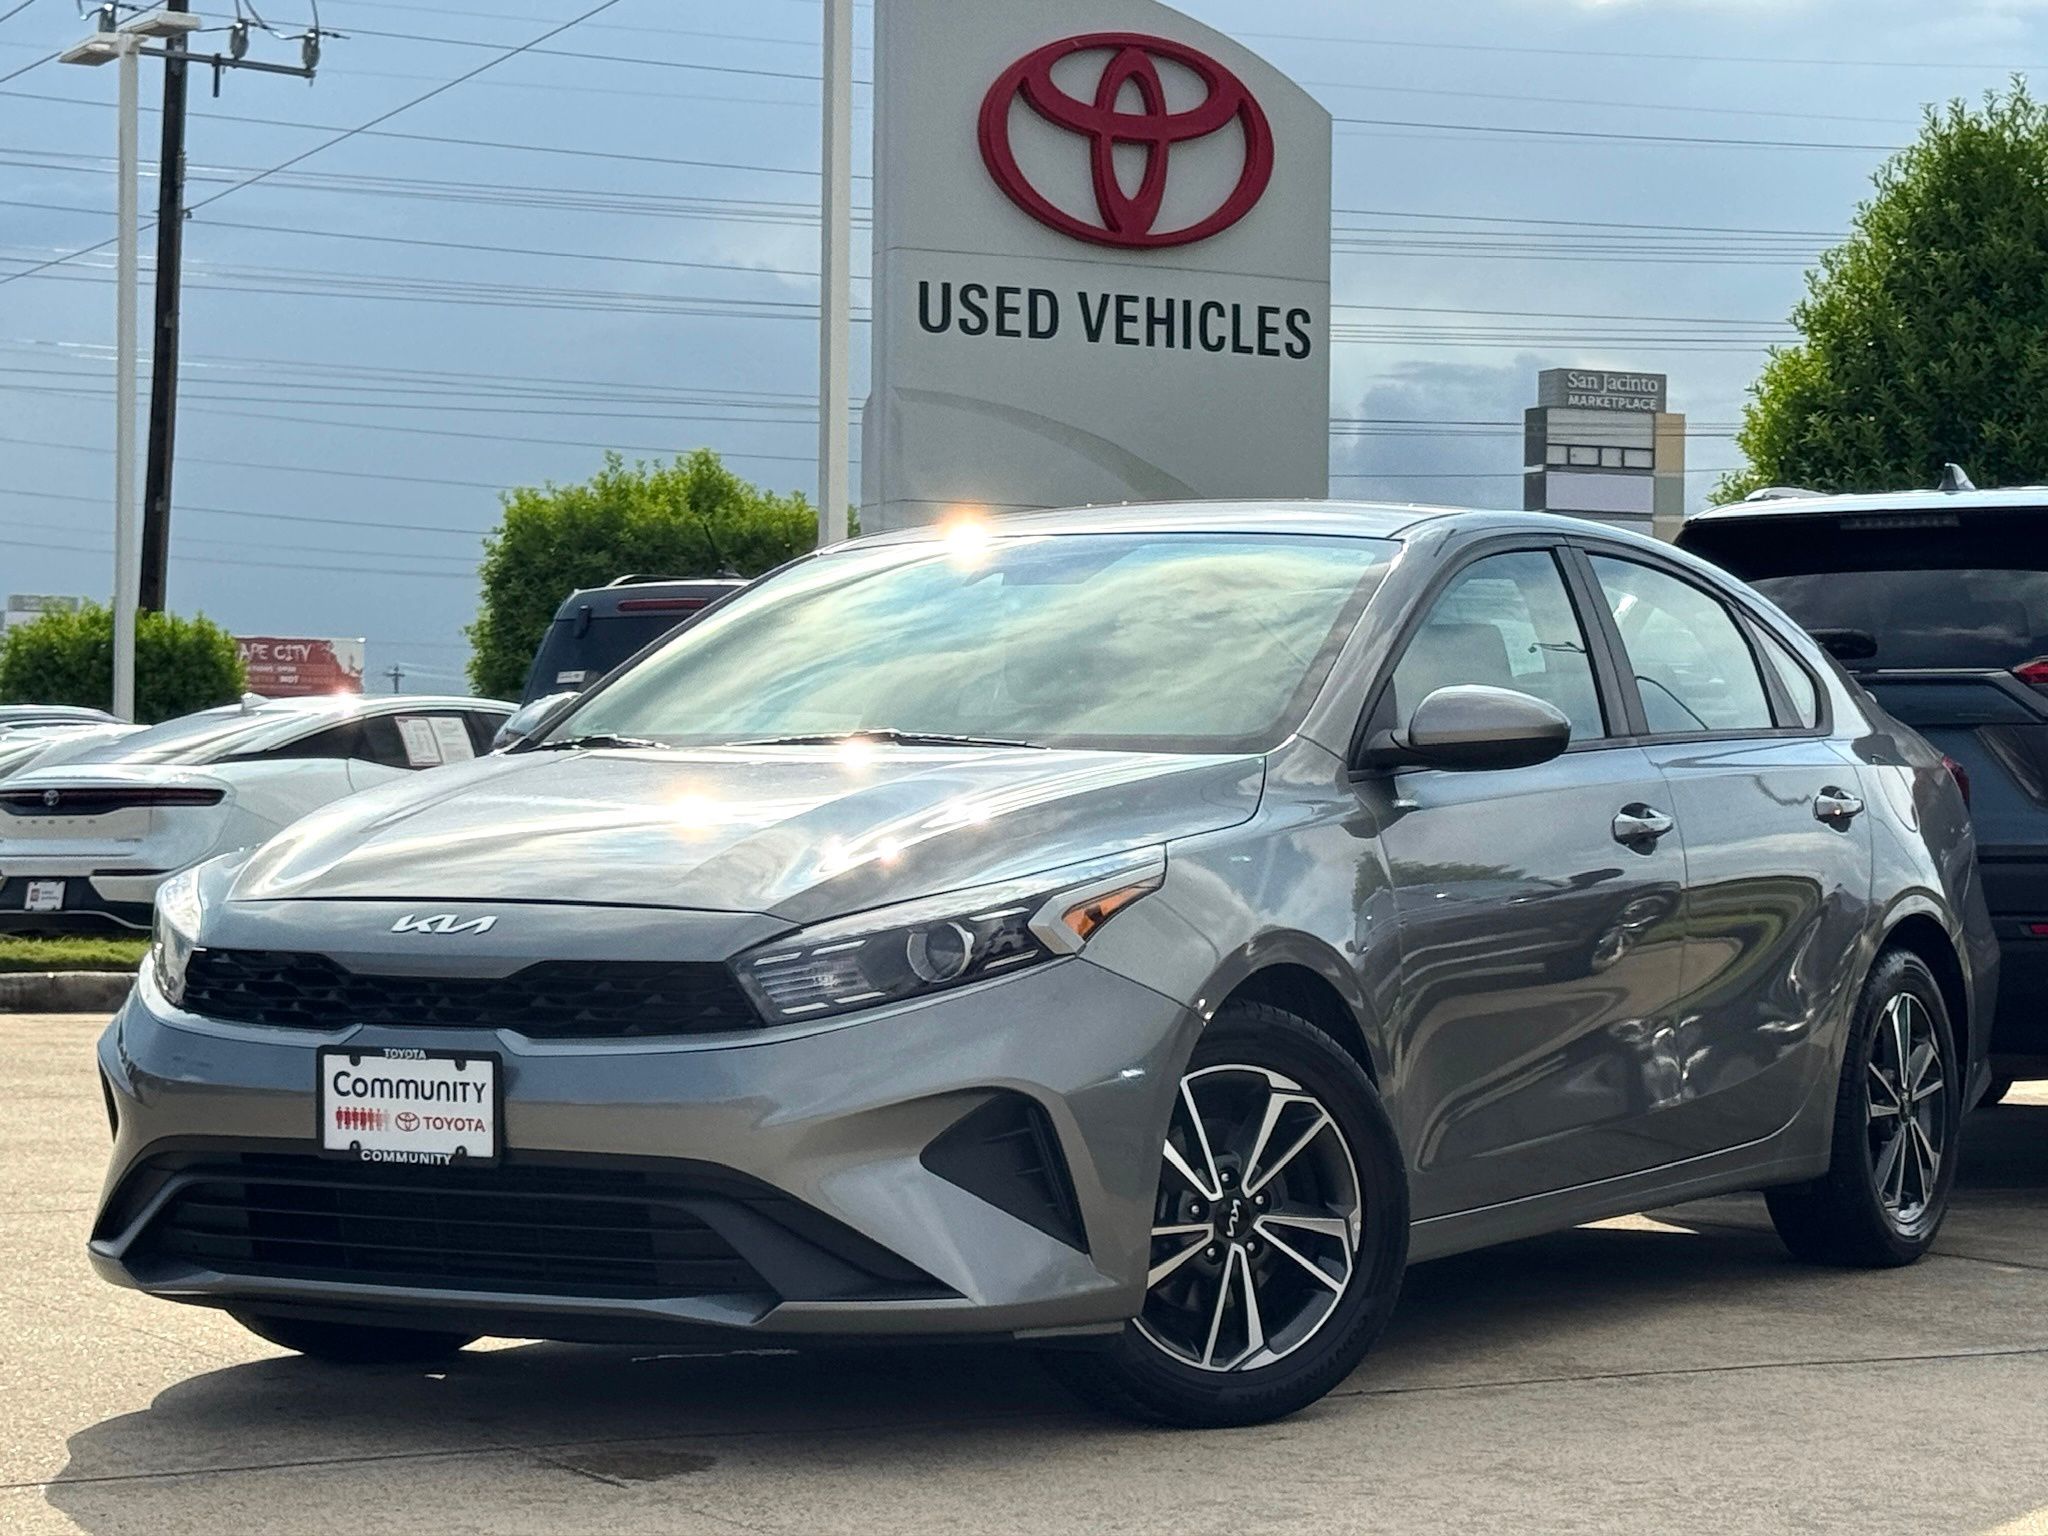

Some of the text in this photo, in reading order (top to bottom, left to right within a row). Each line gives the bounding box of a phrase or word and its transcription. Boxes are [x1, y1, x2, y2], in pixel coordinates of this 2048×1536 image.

[918, 281, 1311, 360] USED VEHICLES
[1568, 371, 1658, 394] San Jacinto
[1568, 394, 1657, 411] MARKETPLACE
[273, 643, 312, 662] CITY
[390, 913, 498, 935] KIA
[383, 1048, 428, 1060] TOYOTA
[423, 1116, 486, 1133] TOYOTA
[360, 1149, 453, 1166] COMMUNITY
